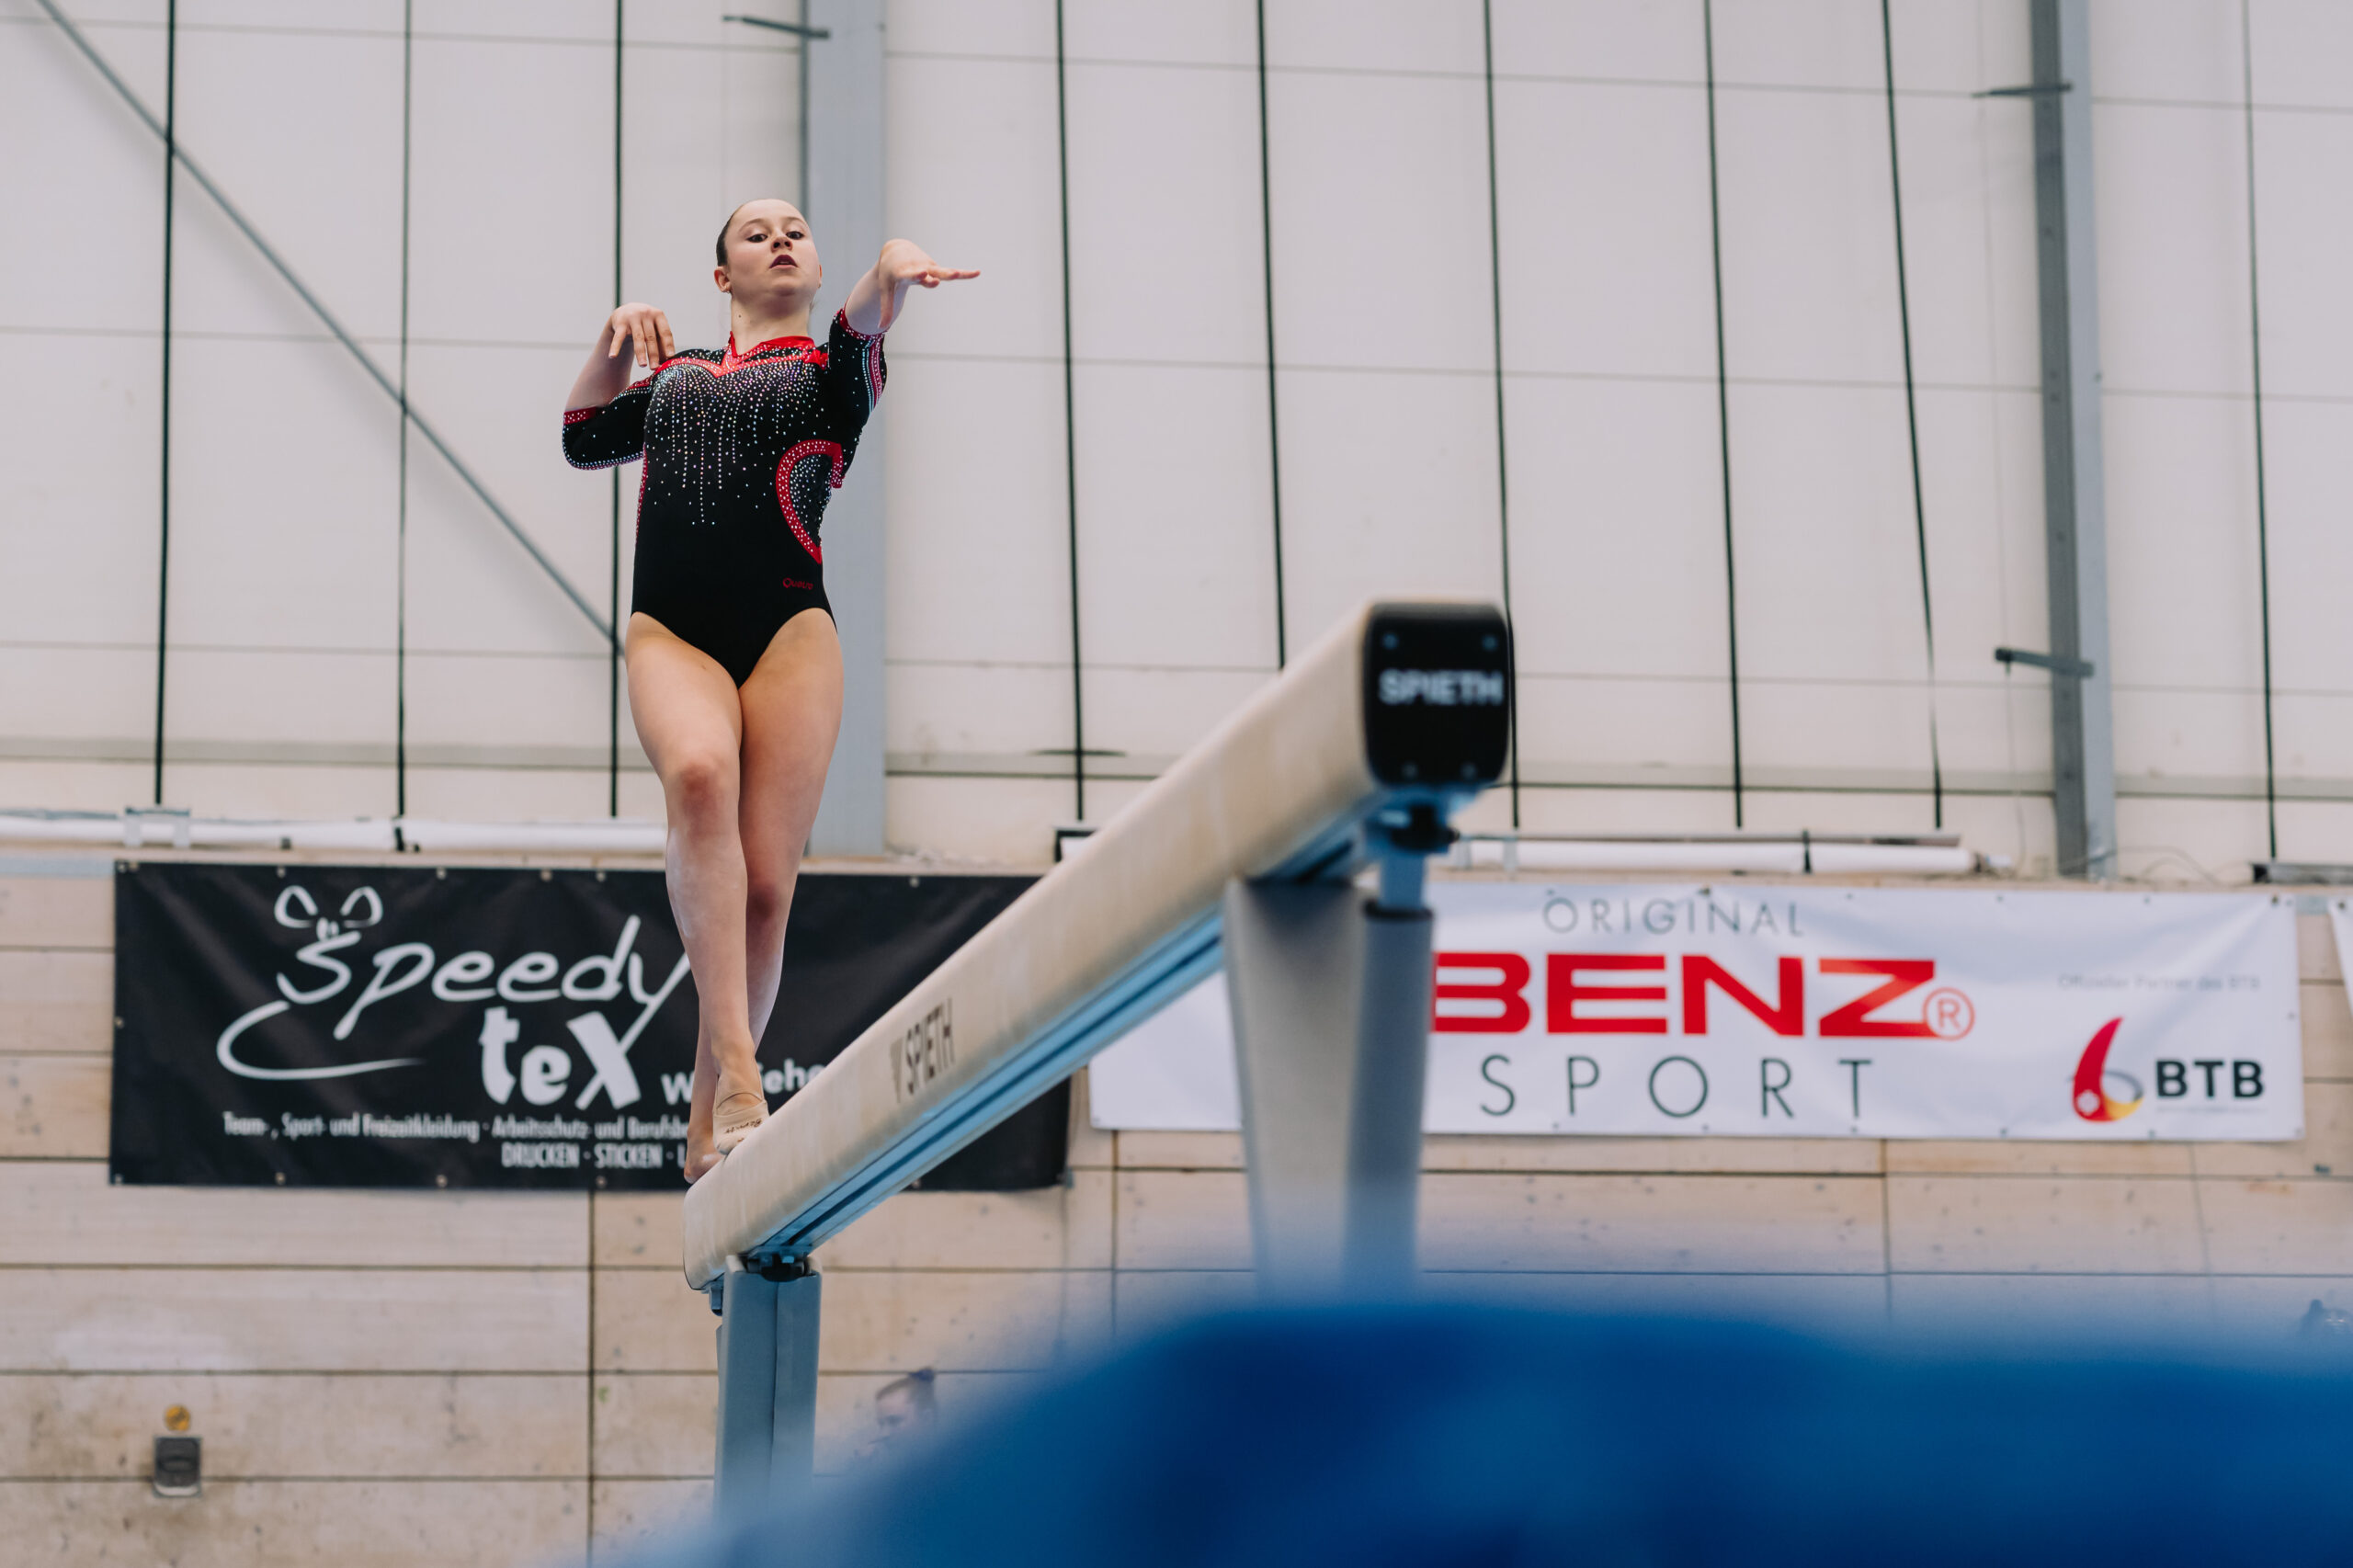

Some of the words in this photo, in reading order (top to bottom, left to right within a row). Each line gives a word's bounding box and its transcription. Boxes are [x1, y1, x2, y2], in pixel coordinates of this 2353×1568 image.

[1380, 669, 1503, 705] SPIETH
[1541, 897, 1804, 937] ORIGINAL
[276, 915, 691, 1040] Speedy
[1430, 952, 1936, 1038] BENZ
[904, 996, 955, 1095] SPIETH
[1480, 1054, 1872, 1119] SPORT
[2155, 1060, 2265, 1098] BTB
[329, 1111, 361, 1137] und
[594, 1115, 626, 1139] und
[501, 1142, 580, 1168] DRUCKEN
[594, 1142, 664, 1169] STICKEN
